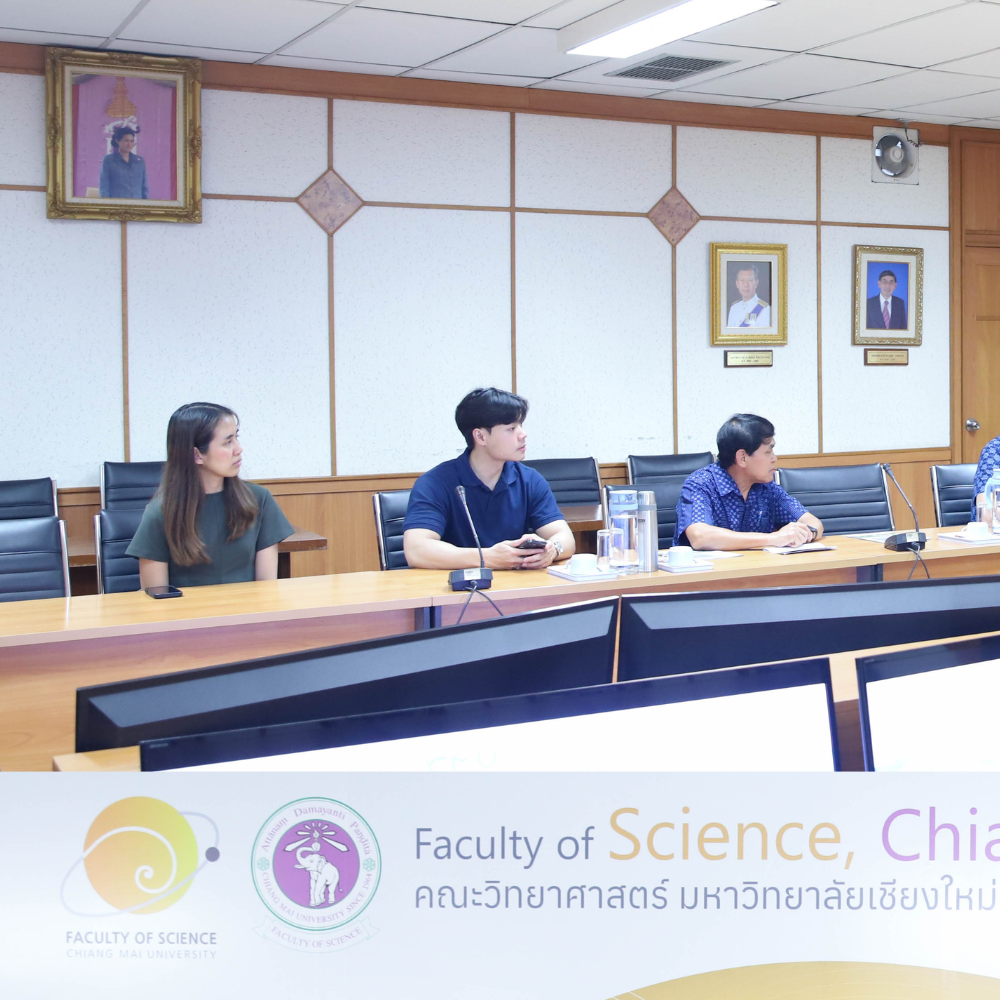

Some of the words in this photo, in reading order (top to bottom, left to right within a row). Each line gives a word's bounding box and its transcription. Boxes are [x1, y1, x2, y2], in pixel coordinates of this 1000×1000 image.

[415, 826, 543, 869] Faculty
[556, 826, 595, 861] of
[608, 806, 856, 870] Science,
[262, 871, 281, 904] CHIANG
[280, 902, 295, 917] MAI
[296, 909, 345, 924] UNIVERSITY
[346, 890, 366, 913] SINCE
[415, 878, 669, 909] คณะวิทยาศาสตร์
[680, 874, 998, 911] มหาวิทยาลัยเชียงใหม่
[66, 931, 129, 944] FACULTY
[135, 932, 153, 944] OF
[158, 932, 217, 945] SCIENCE
[271, 926, 310, 948] FACULTY
[312, 940, 324, 949] OF
[326, 926, 363, 948] SCIENCE
[66, 949, 114, 959] CHIANG
[119, 949, 142, 959] MAI
[147, 950, 217, 960] UNIVERSITY
